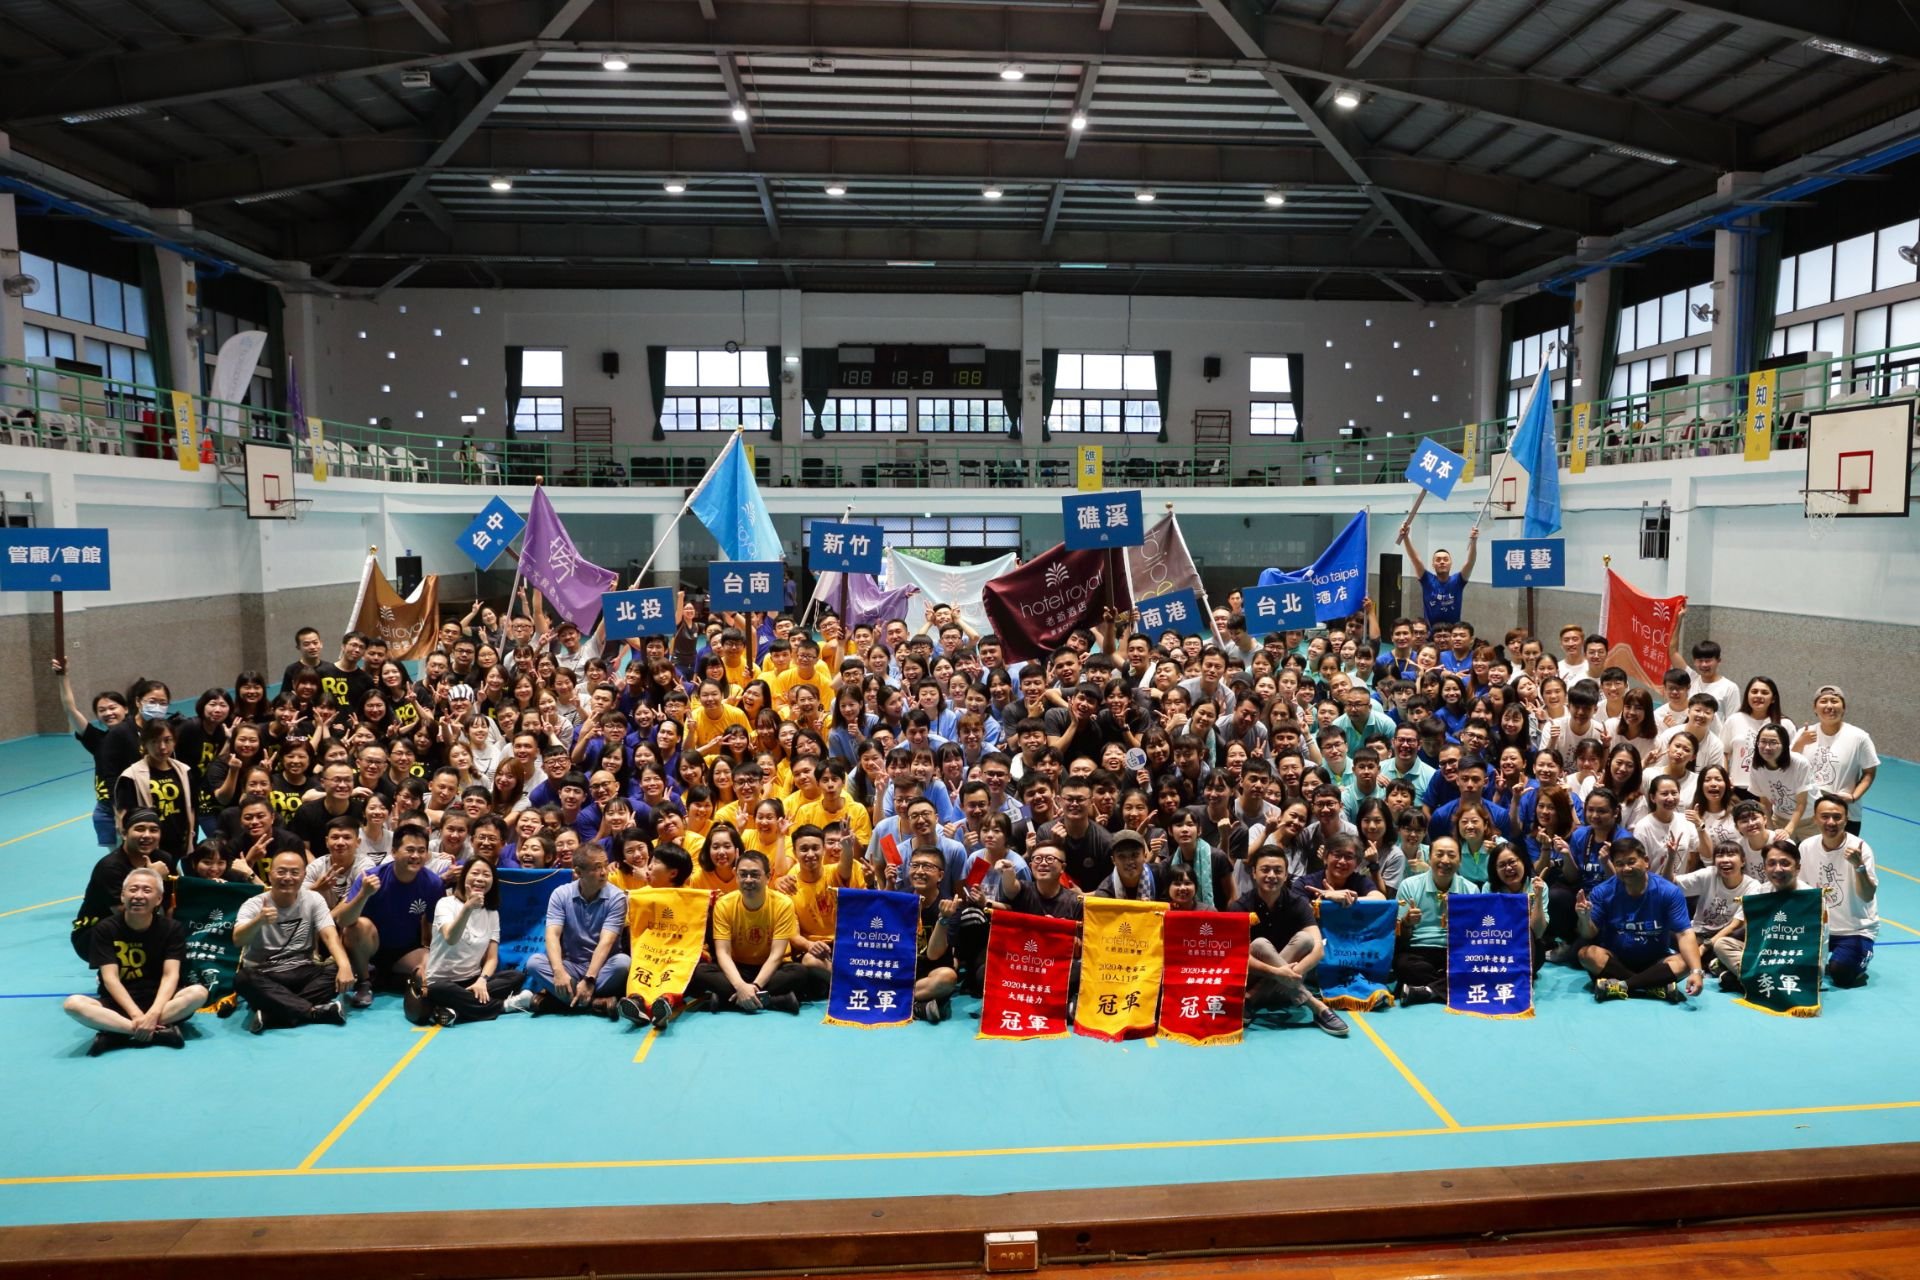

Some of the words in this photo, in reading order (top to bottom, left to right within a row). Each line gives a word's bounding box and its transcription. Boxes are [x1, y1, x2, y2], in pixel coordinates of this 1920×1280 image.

[1754, 385, 1768, 433] 知本
[1419, 450, 1454, 479] 知本
[1077, 503, 1129, 530] 礁溪
[472, 512, 503, 551] 台中
[8, 545, 101, 563] 管顧/會館
[823, 533, 871, 556] 新竹
[1505, 548, 1552, 571] 傳藝
[723, 572, 770, 594] 台南
[1330, 564, 1359, 582] taipei
[1020, 588, 1065, 618] hotel
[1065, 569, 1103, 602] royal
[1257, 593, 1302, 617] 台北
[616, 598, 662, 621] 北投
[1141, 601, 1187, 630] 南港
[1631, 614, 1651, 640] the
[321, 677, 348, 695] RO
[269, 790, 303, 812] RO
[853, 930, 878, 941] hoel
[878, 931, 900, 943] royal
[1466, 929, 1490, 938] hoel
[1490, 929, 1513, 939] royal
[1781, 925, 1805, 935] royal
[1183, 939, 1207, 948] hoel
[1208, 939, 1232, 950] royal
[849, 958, 899, 969] 2020年老爺盃
[1006, 951, 1030, 964] hoel
[1031, 956, 1055, 968] royal
[1002, 979, 1051, 994] 2020年老爺盃
[1465, 983, 1516, 1006] 亞軍
[1757, 972, 1802, 999] 季軍
[845, 989, 898, 1013] 亞軍
[1008, 991, 1043, 1005] 大隊接力
[1096, 990, 1142, 1016] 冠軍
[1179, 995, 1226, 1021] 冠軍
[1000, 1009, 1050, 1031] 冠軍
